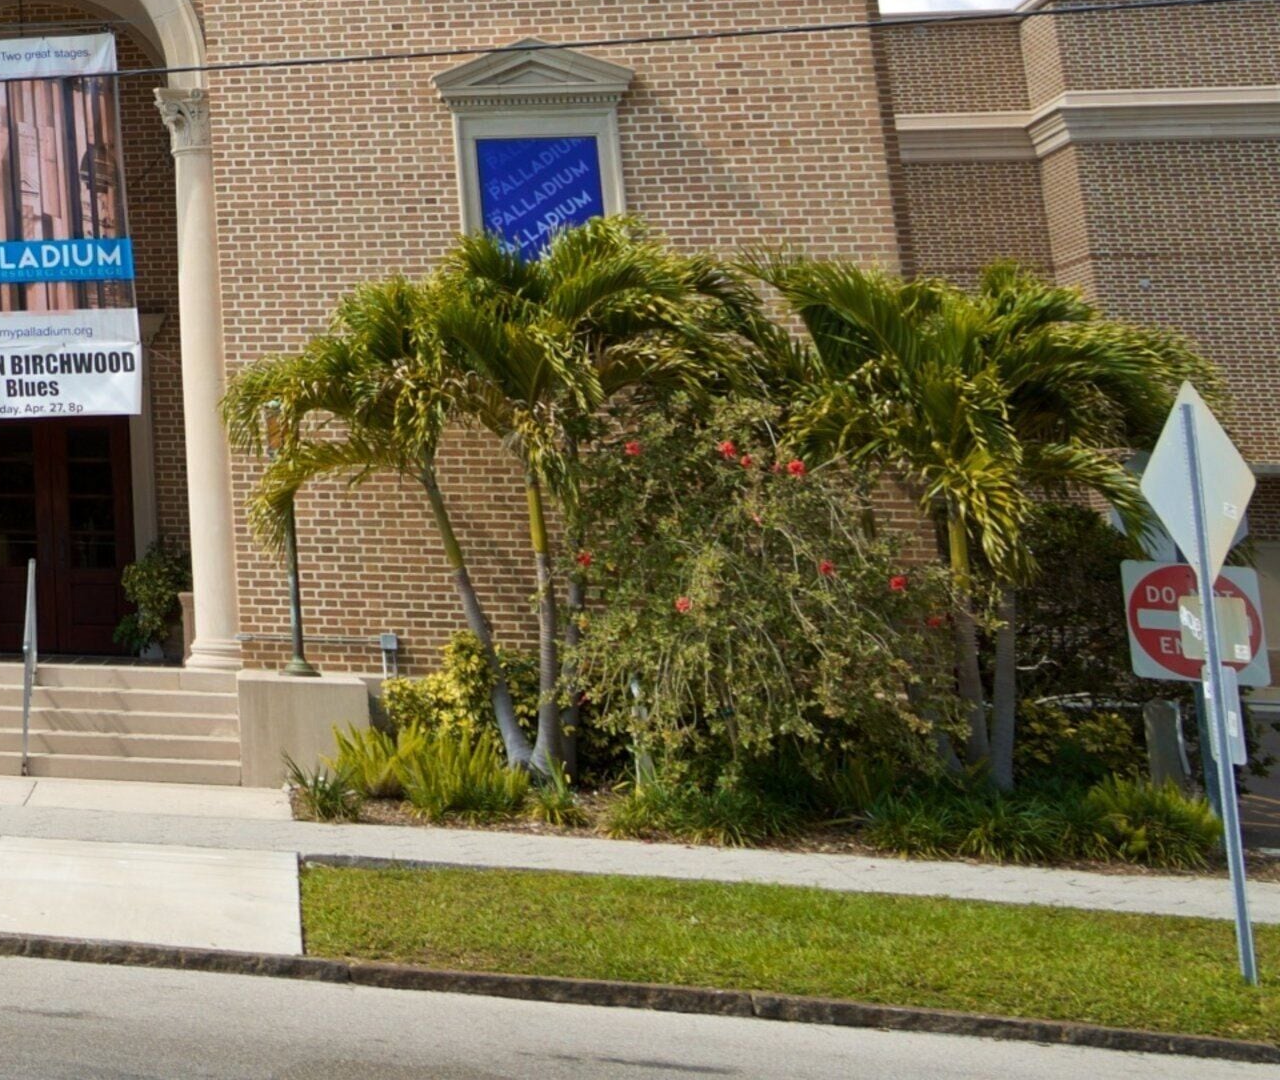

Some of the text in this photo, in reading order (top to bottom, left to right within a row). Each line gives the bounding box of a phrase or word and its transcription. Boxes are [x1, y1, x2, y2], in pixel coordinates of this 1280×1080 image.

[1, 51, 22, 61] Two
[25, 50, 51, 62] great
[53, 48, 91, 60] stages.
[491, 158, 590, 233] PALLADIUM
[10, 351, 135, 376] BIRCHWOOD
[6, 379, 59, 397] Blues
[24, 403, 46, 414] Apr.
[68, 402, 83, 413] 8p
[1145, 585, 1176, 604] DO
